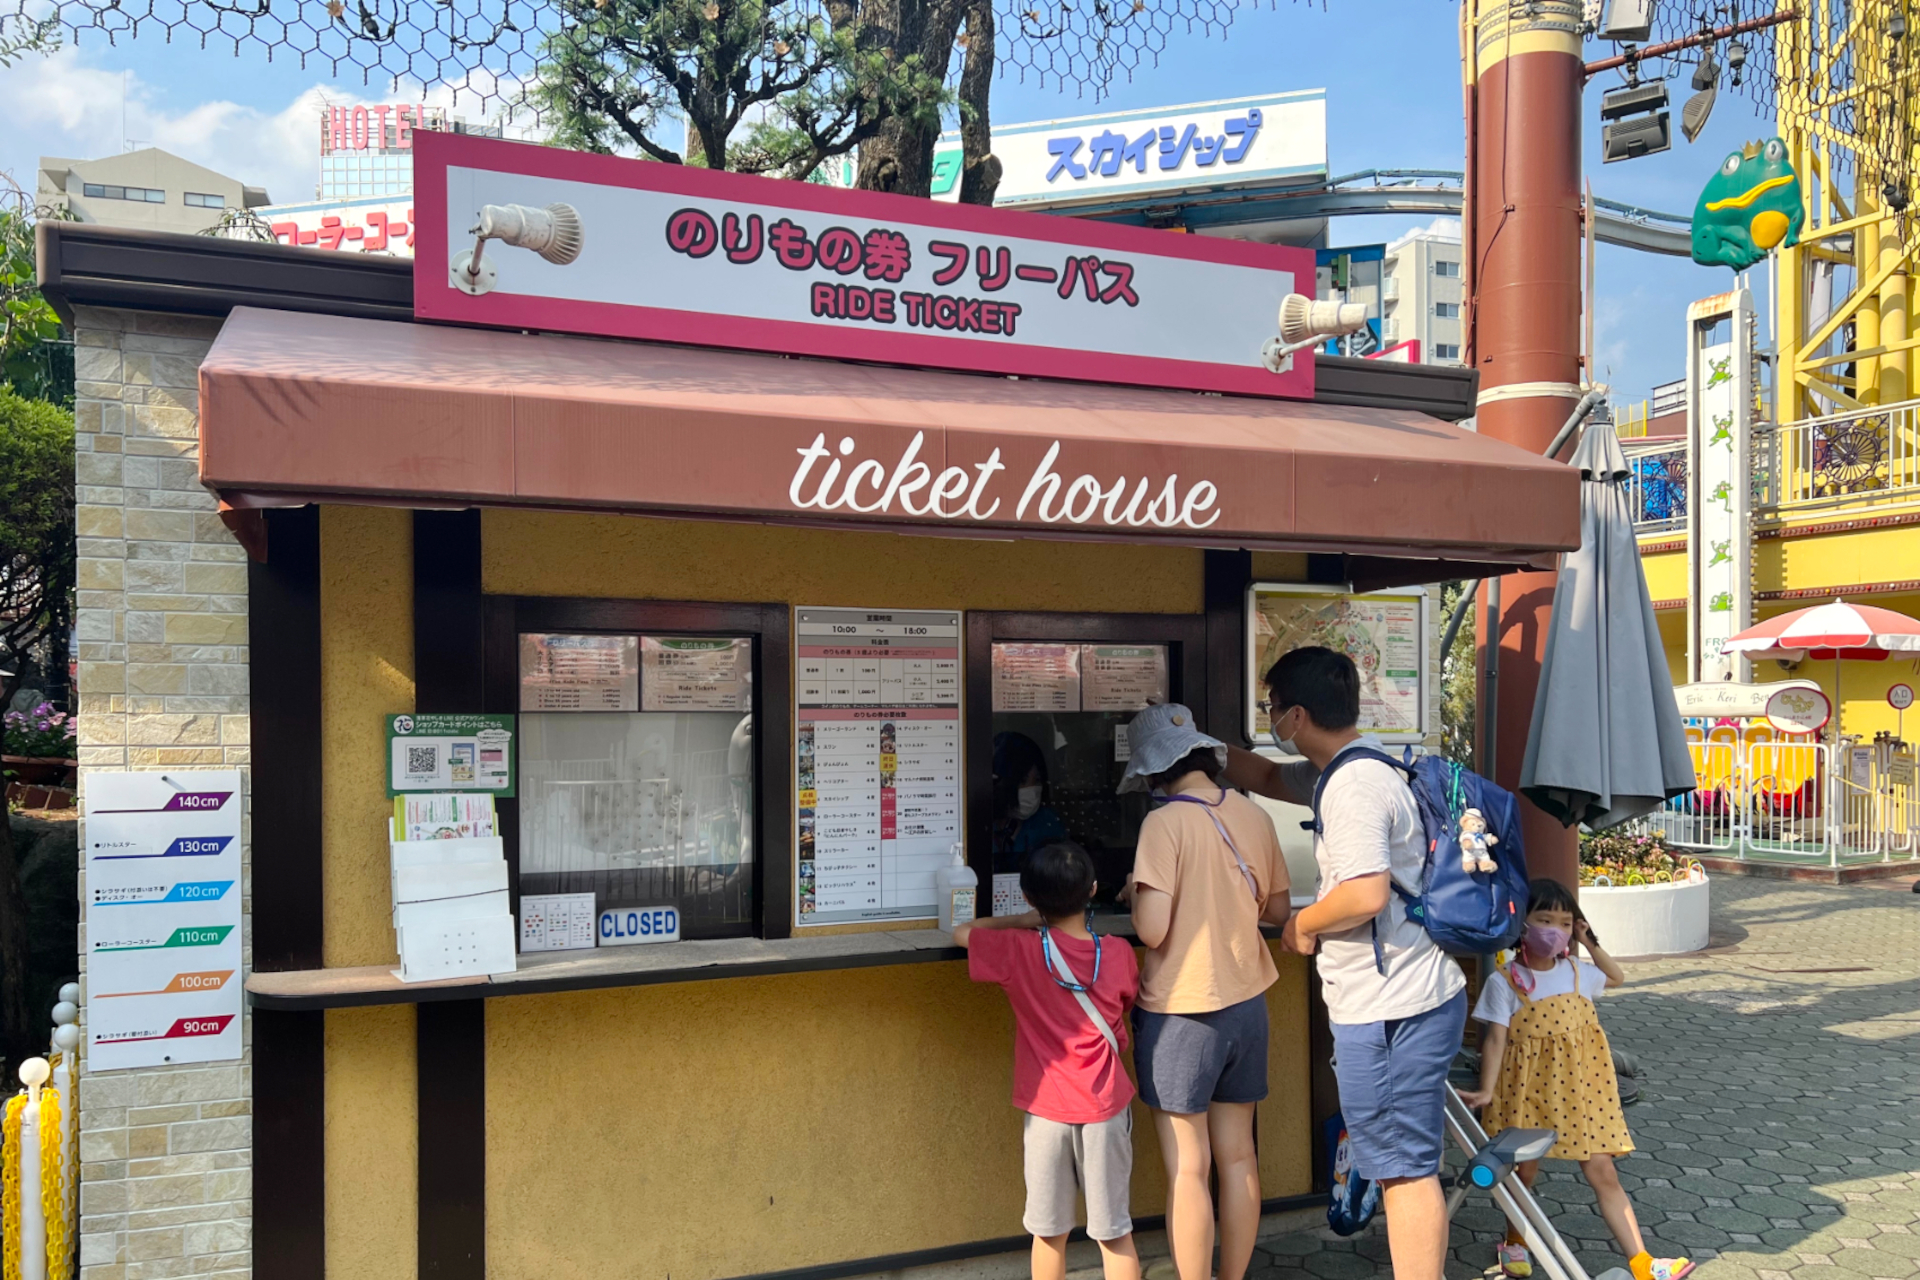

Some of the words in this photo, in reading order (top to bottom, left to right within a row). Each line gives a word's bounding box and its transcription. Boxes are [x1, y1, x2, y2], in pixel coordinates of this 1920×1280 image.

[1046, 108, 1263, 183] スカイシップ
[666, 208, 911, 283] のりもの券
[928, 239, 1140, 306] フリーパス
[812, 283, 896, 324] RIDE
[901, 291, 1020, 336] TICKET
[790, 432, 1005, 520] ticket
[1013, 438, 1221, 531] house
[1685, 693, 1704, 705] Eric
[1894, 690, 1907, 698] 入口
[102, 939, 157, 948] ローラーコースター
[601, 911, 676, 938] CLOSED
